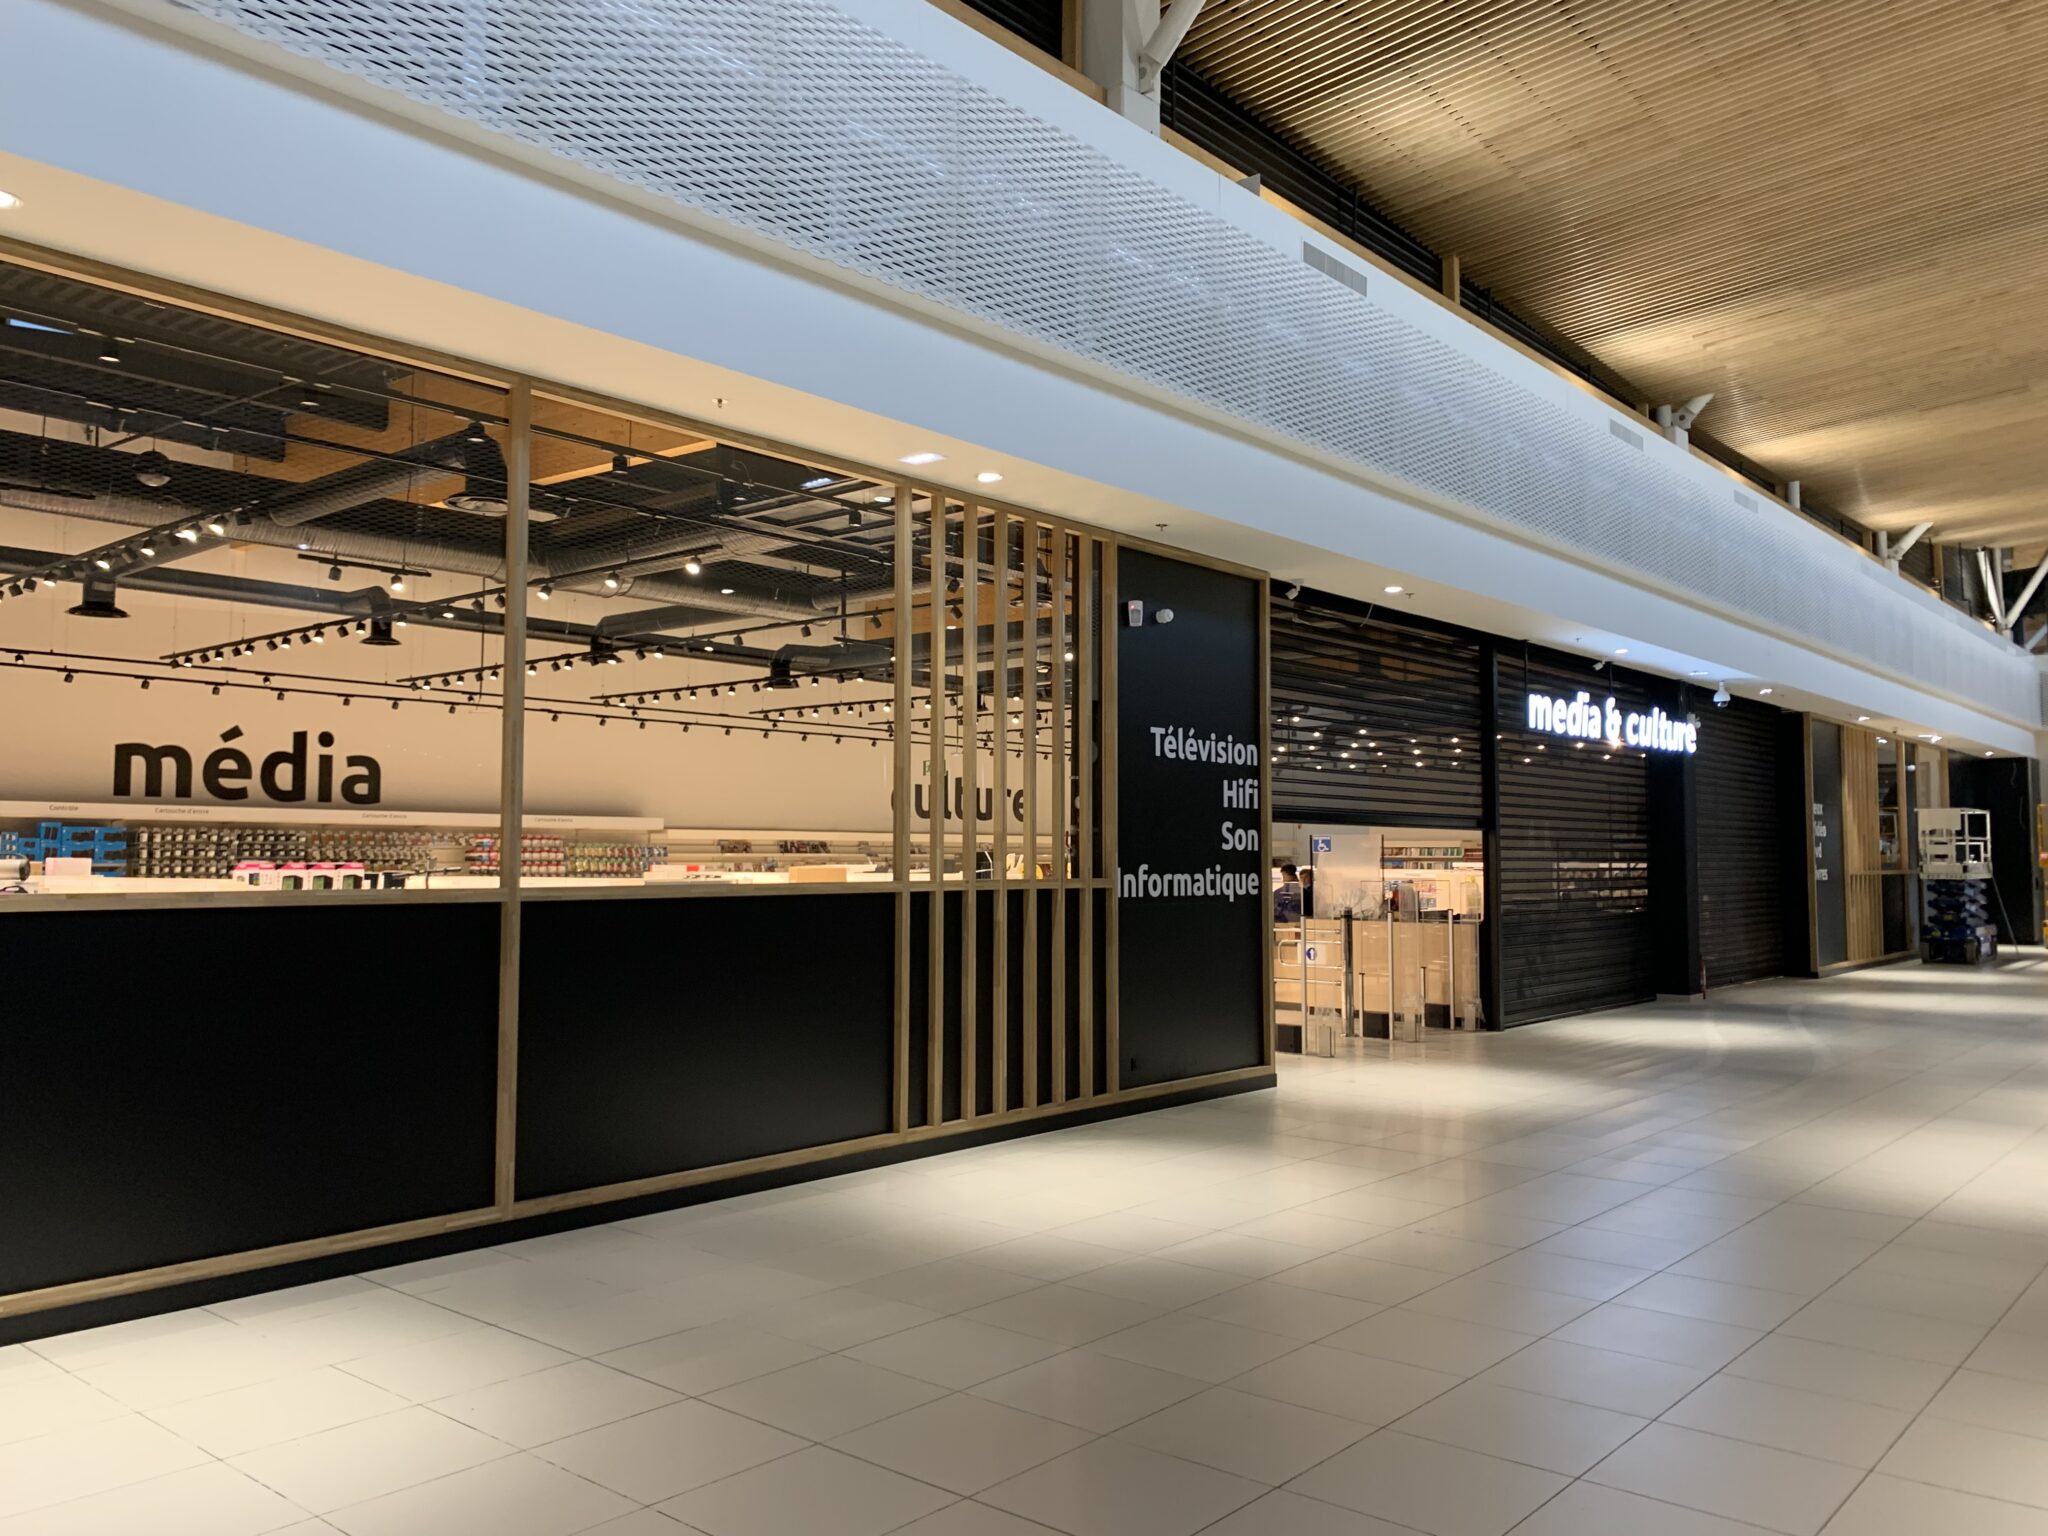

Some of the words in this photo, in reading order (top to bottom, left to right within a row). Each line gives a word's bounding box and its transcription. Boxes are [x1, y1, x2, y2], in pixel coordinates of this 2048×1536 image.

[1528, 691, 1602, 739] media
[1605, 697, 1622, 742] &
[1626, 707, 1697, 754] culture
[113, 725, 382, 805] média
[1150, 725, 1258, 767] Télévision
[1223, 778, 1259, 809] Hifi
[1221, 821, 1259, 851] Son
[1117, 864, 1260, 902] Informatique
